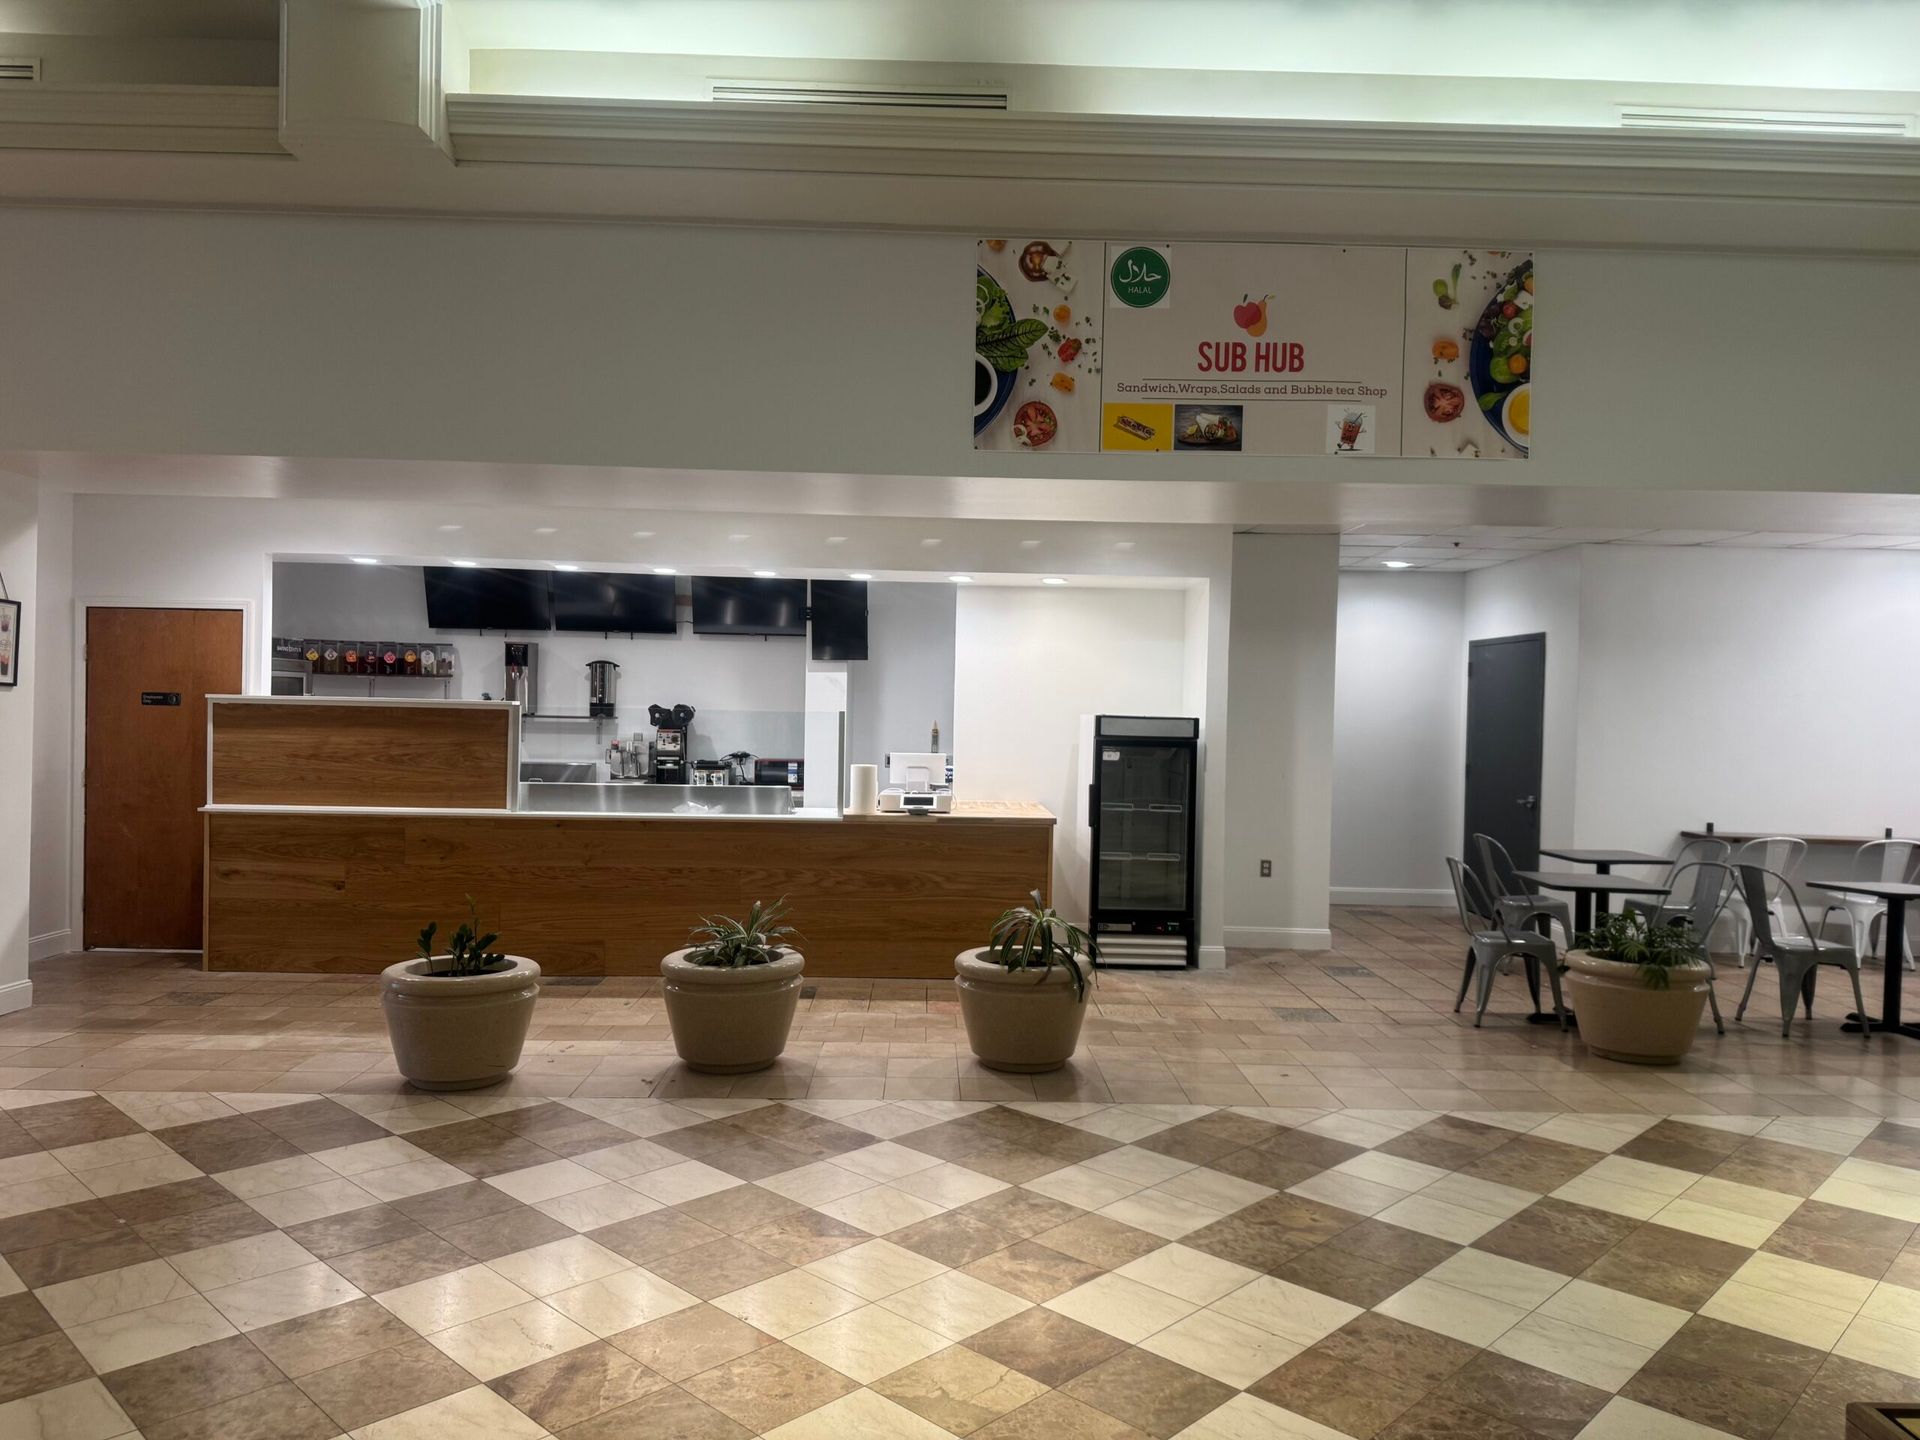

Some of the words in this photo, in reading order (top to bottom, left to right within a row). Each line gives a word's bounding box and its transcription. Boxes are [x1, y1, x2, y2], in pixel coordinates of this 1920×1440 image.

[1118, 259, 1162, 283] حلال
[1127, 286, 1152, 294] HALAL
[1197, 341, 1247, 373] SUB
[1254, 342, 1305, 373] HUB
[1263, 385, 1288, 395] and
[1290, 384, 1334, 395] Bubble
[1335, 385, 1355, 396] tea
[1357, 386, 1388, 399] Shop
